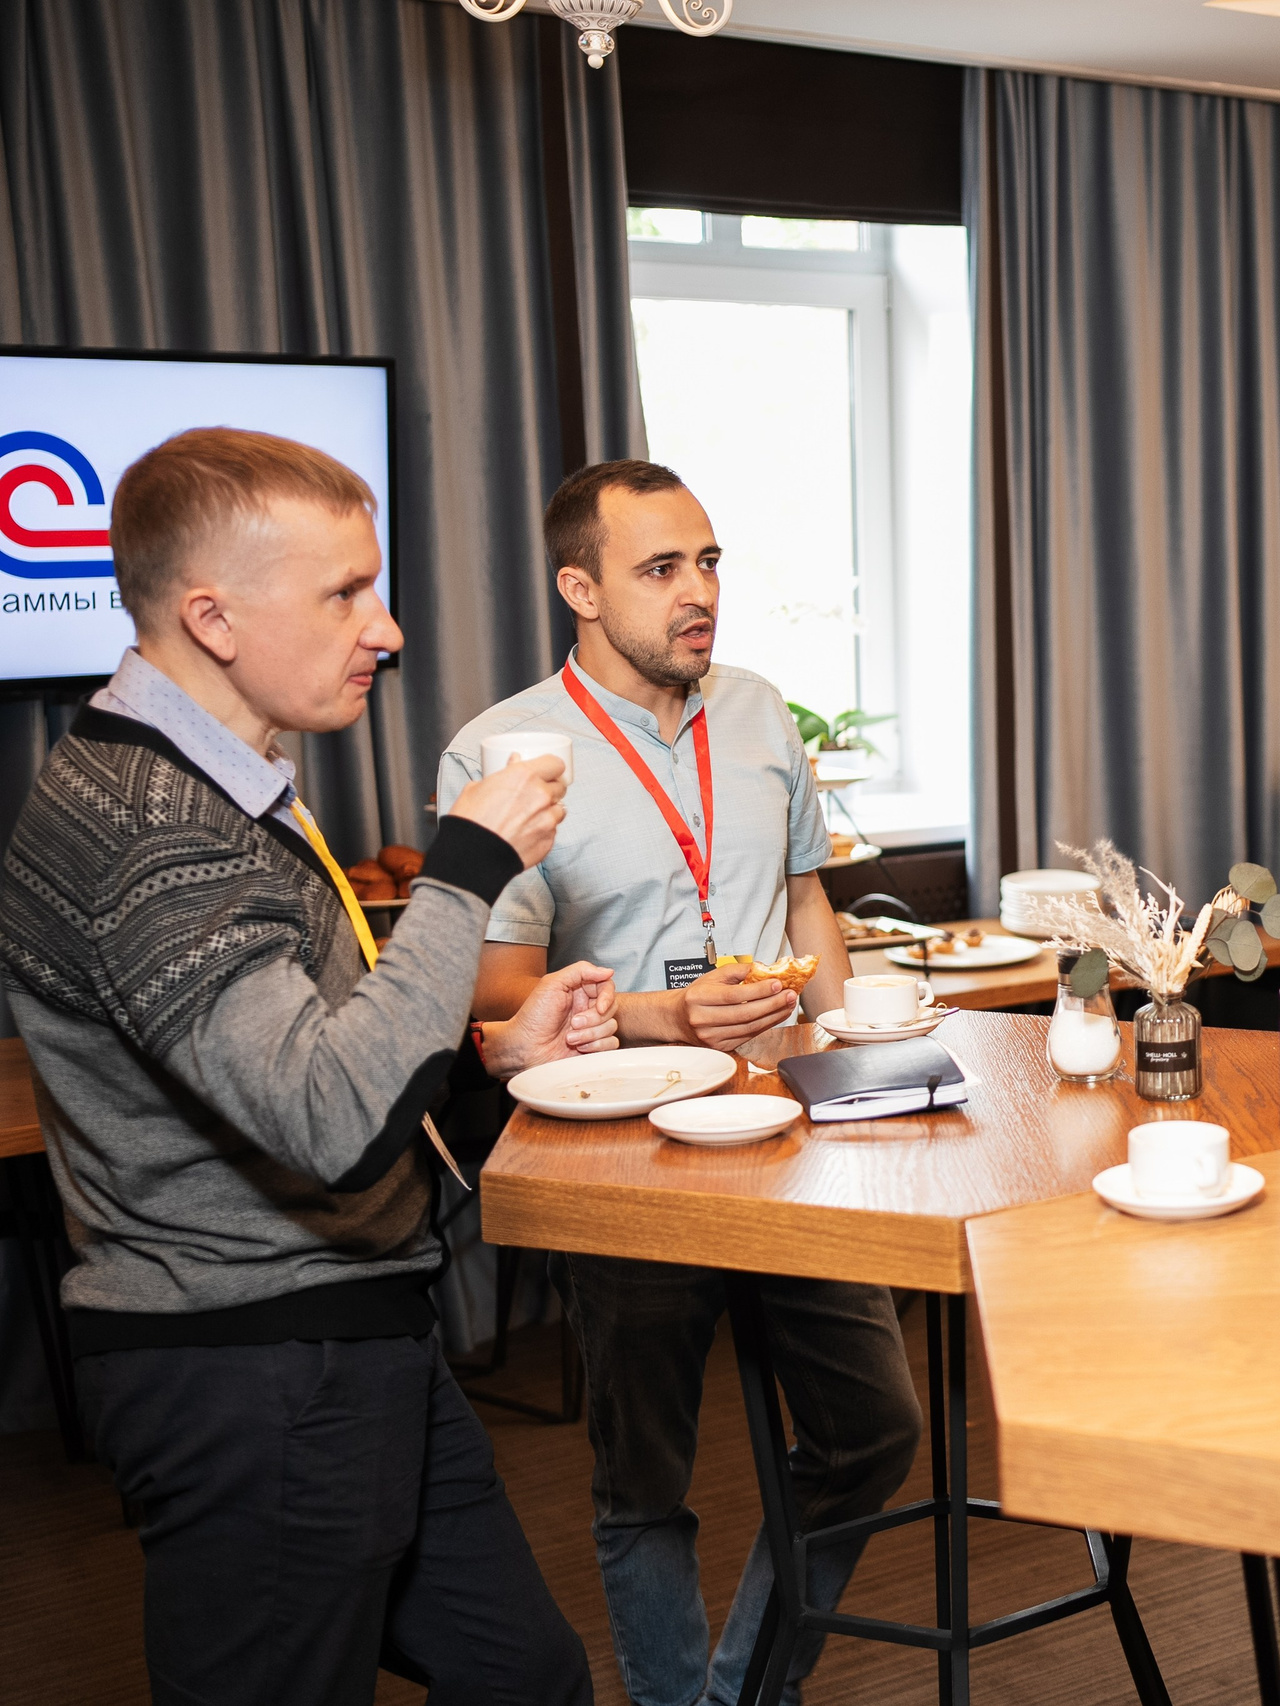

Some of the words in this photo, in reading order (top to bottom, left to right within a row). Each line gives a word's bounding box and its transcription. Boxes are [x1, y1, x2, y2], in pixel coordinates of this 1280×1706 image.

[3, 591, 96, 613] аммы
[669, 964, 703, 972] Скачайте
[670, 972, 704, 981] приложе
